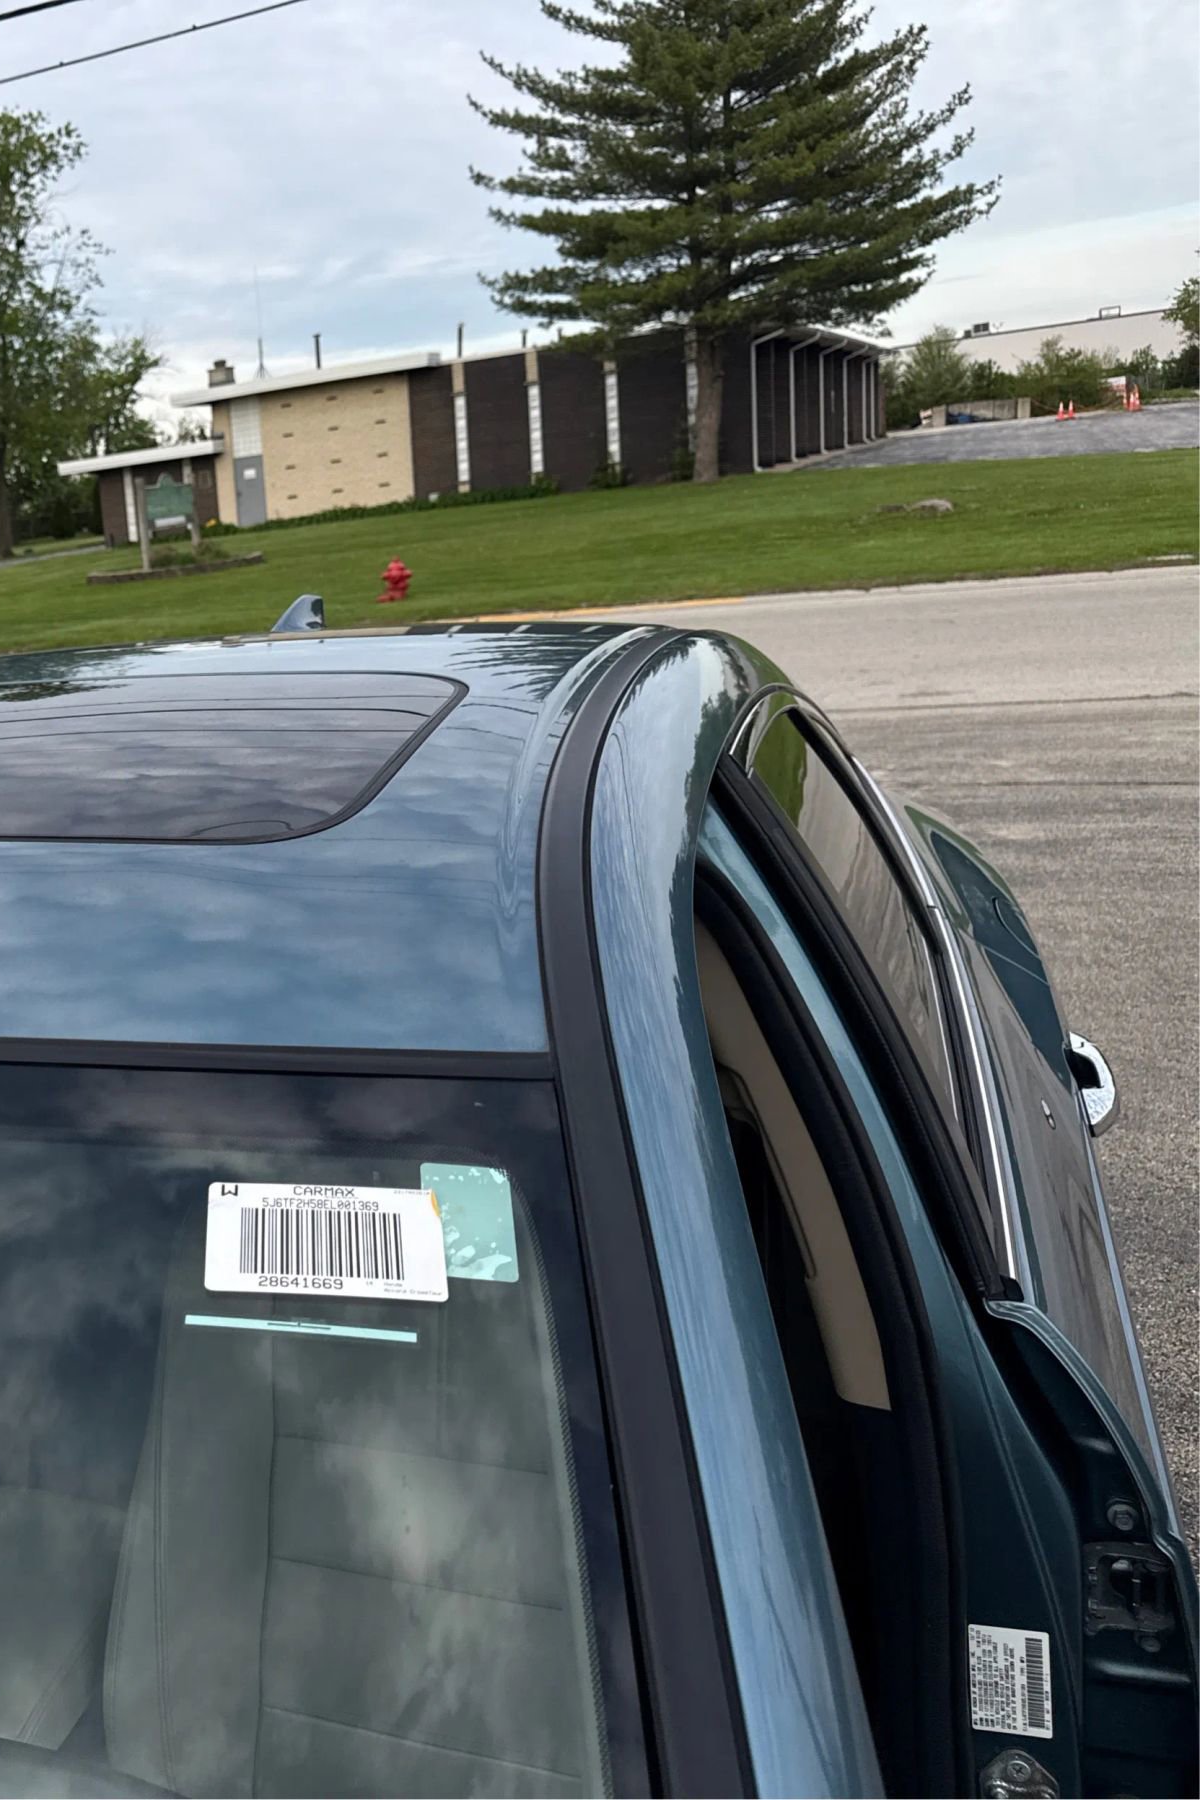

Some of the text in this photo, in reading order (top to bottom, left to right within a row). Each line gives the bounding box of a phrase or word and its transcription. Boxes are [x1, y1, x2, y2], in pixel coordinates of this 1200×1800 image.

[293, 1186, 355, 1197] CARMAX
[262, 1197, 379, 1212] 5J6TF2H58EL001369
[258, 1276, 343, 1290] 28641669
